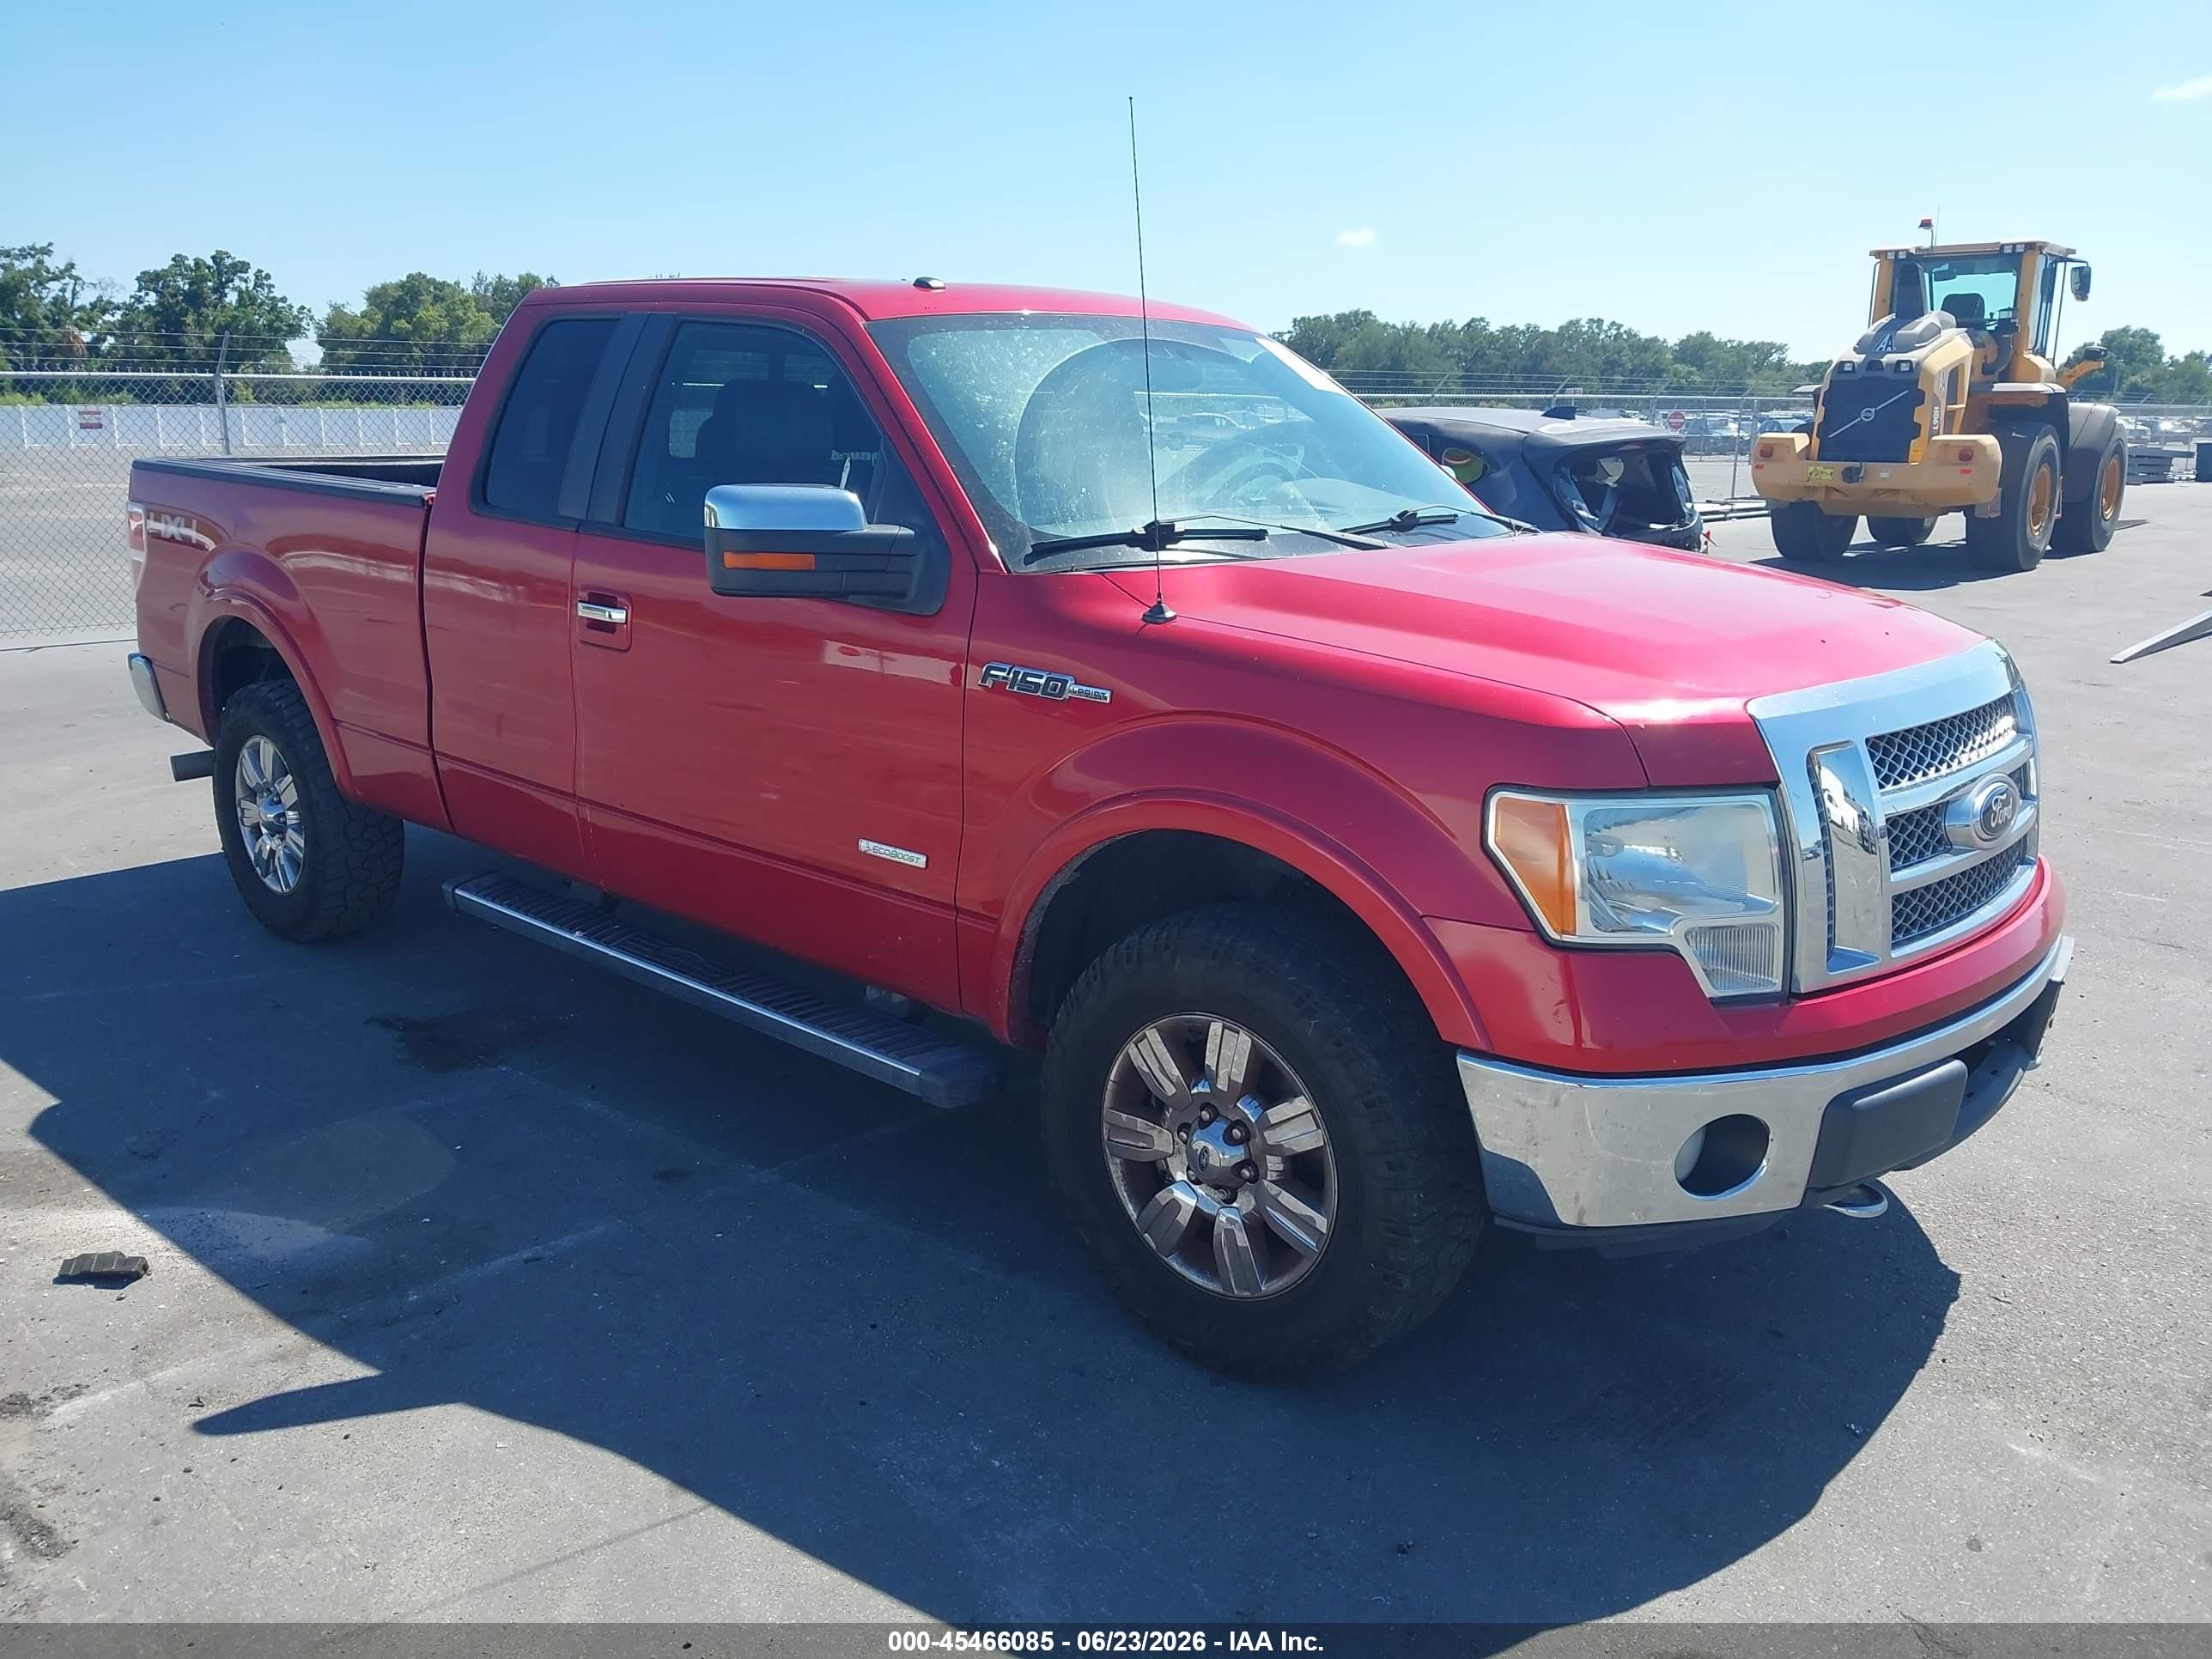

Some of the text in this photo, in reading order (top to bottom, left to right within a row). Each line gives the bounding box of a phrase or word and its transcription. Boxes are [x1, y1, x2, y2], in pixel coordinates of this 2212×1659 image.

[980, 663, 1108, 702] F-150 LARIAT
[1990, 793, 2013, 828] Ford
